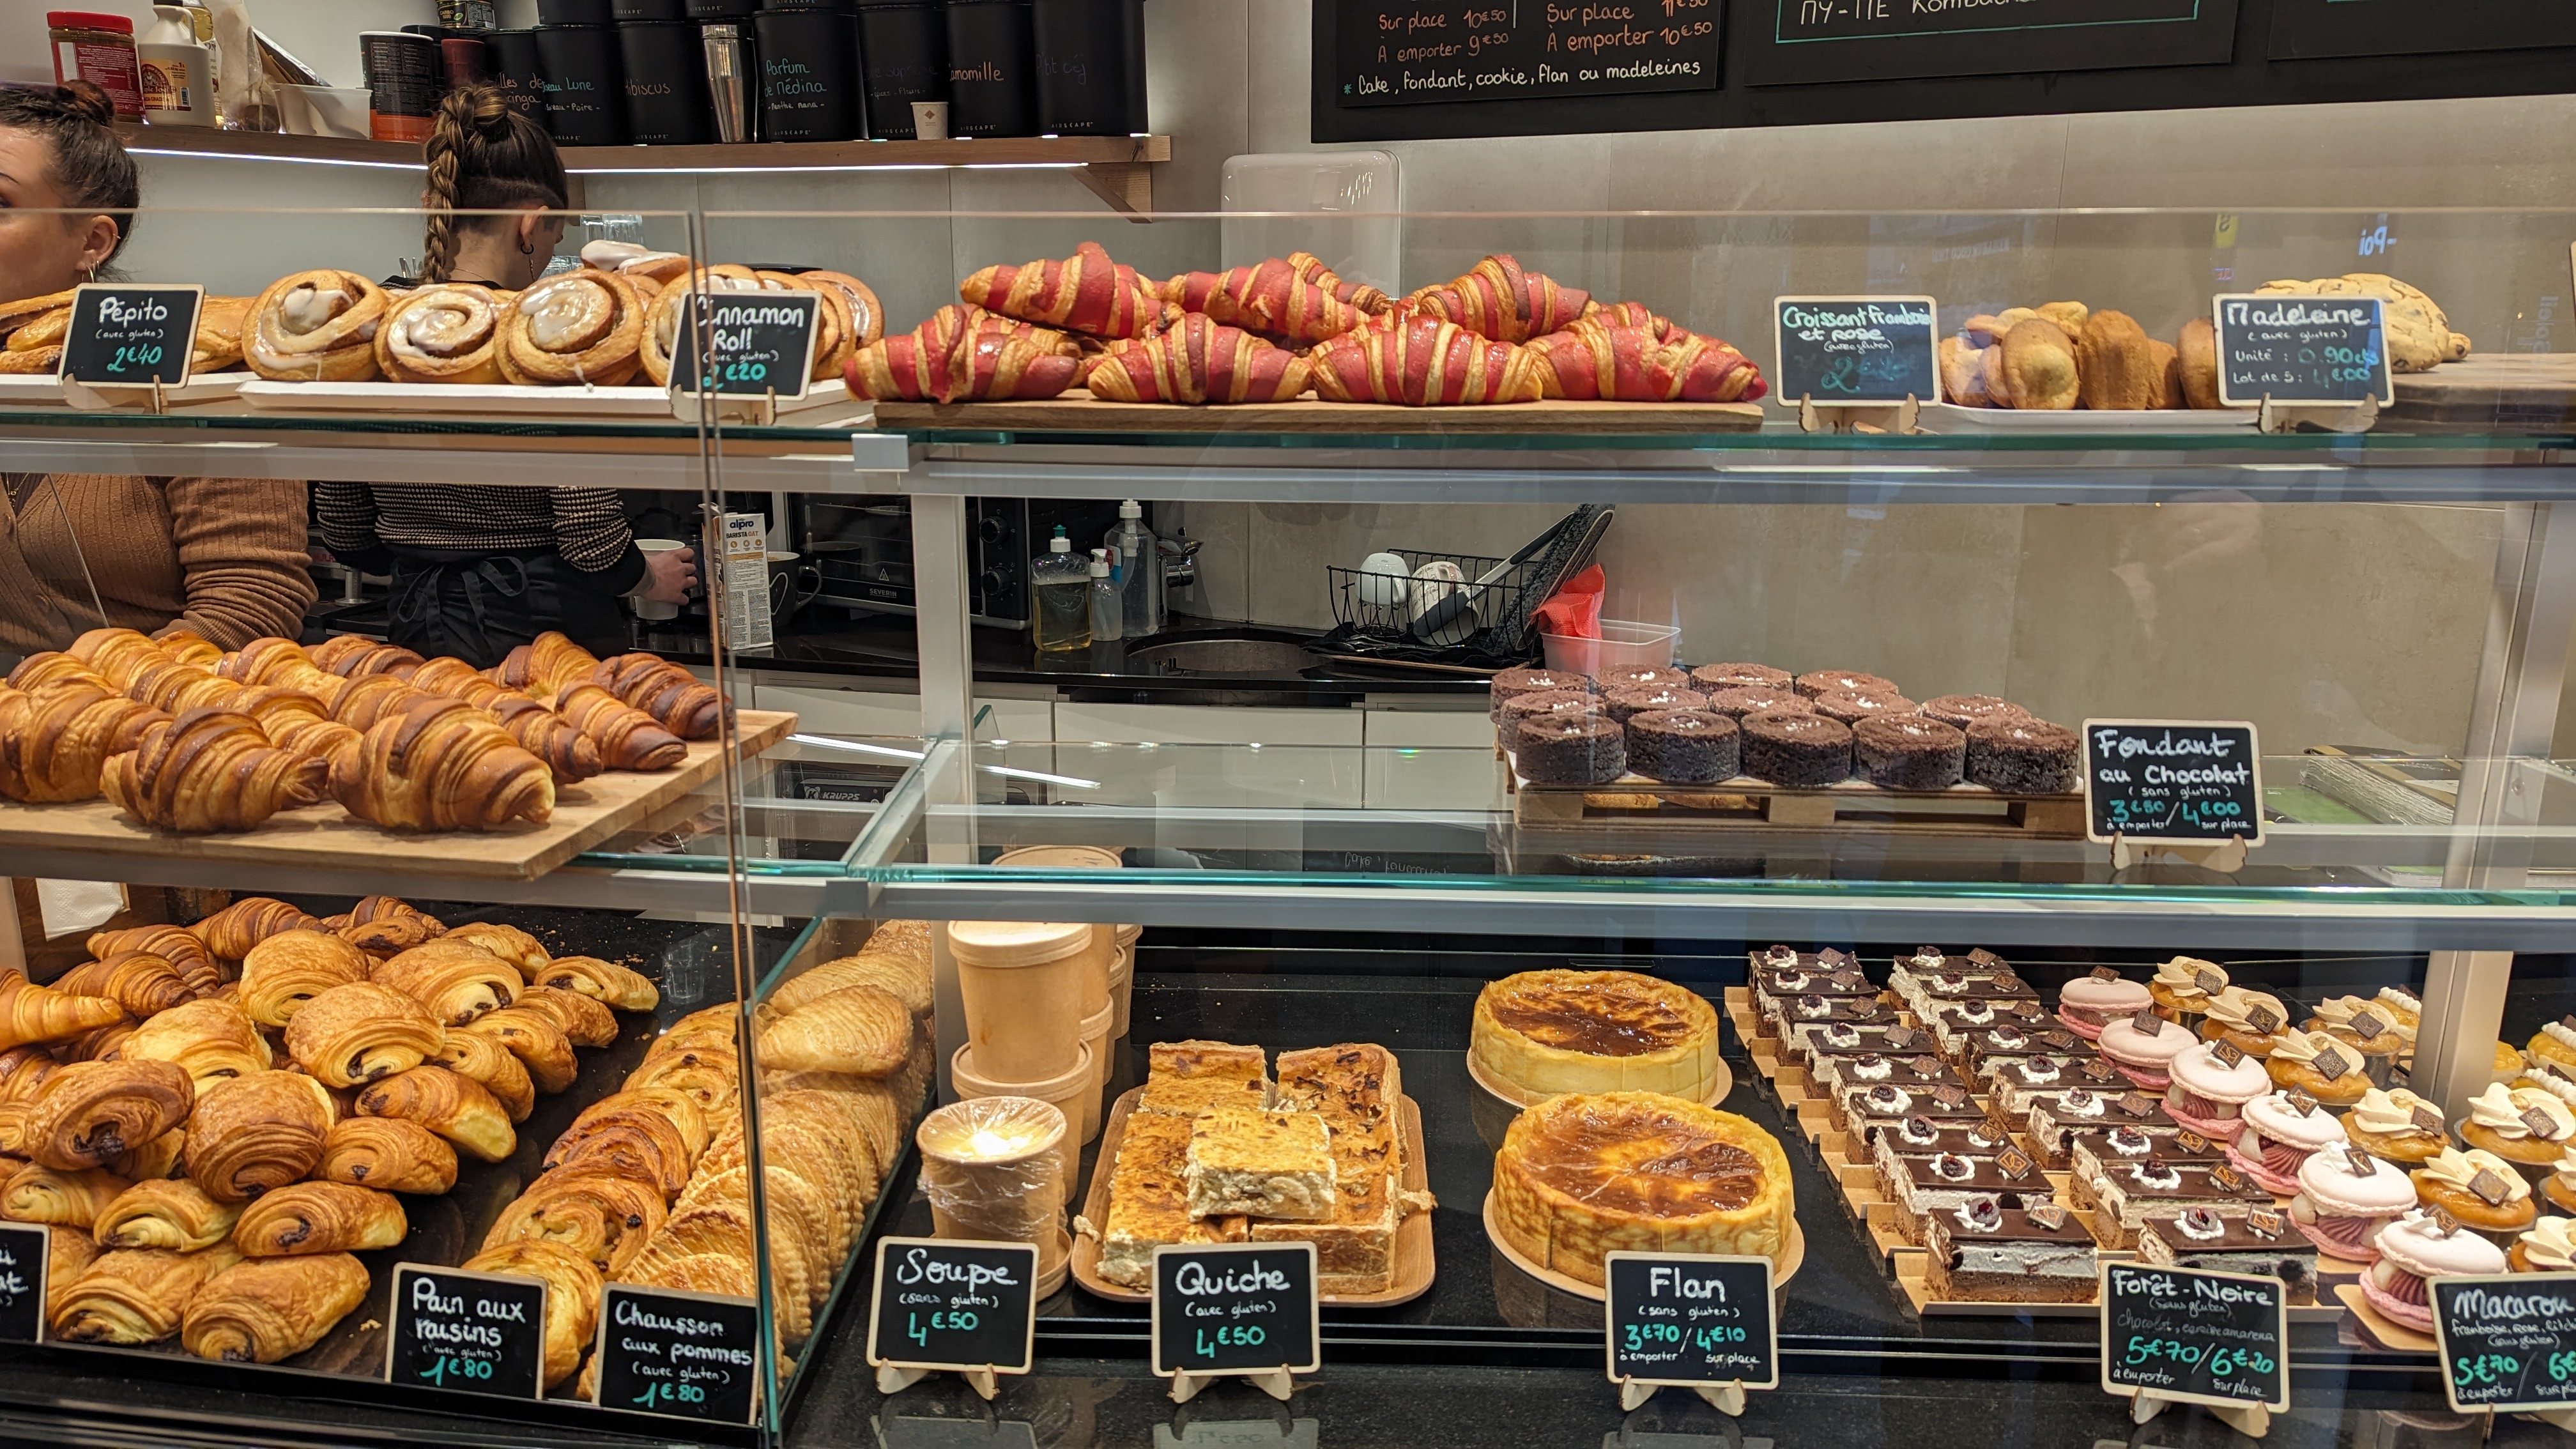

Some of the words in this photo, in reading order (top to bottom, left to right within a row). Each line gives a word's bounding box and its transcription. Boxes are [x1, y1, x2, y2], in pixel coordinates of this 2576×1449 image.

[1379, 13, 1403, 30] Sur
[1409, 11, 1447, 35] place
[1547, 3, 1578, 23] Sur
[1583, 3, 1635, 26] place
[1567, 24, 1654, 56] emporter
[1397, 43, 1462, 63] emporter
[766, 57, 810, 75] Parfum
[949, 61, 1004, 81] amomille
[1539, 64, 1568, 83] flan
[1579, 69, 1599, 80] ou
[1606, 58, 1701, 79] madeleines
[498, 72, 518, 88] lles
[566, 77, 594, 91] Lune
[765, 81, 773, 97] de
[507, 91, 541, 111] ringa
[99, 296, 167, 328] Pépito
[1783, 306, 1868, 328] Croissant
[2227, 302, 2371, 326] Madeleine
[712, 327, 752, 351] Roll
[1798, 328, 1825, 341] et
[1831, 328, 1885, 342] rose
[702, 351, 732, 364] (vec
[2234, 371, 2256, 383] Lot
[2261, 371, 2280, 383] de
[730, 519, 754, 530] alpro
[870, 588, 897, 597] SEVERIN
[2094, 729, 2235, 758] Fondant
[2099, 769, 2131, 783] au
[2144, 762, 2250, 786] Chocolat
[822, 792, 861, 801] KRUPPS
[2106, 818, 2115, 831] à
[2120, 819, 2166, 832] emporter
[2201, 821, 2218, 830] sur
[2221, 818, 2251, 832] place
[896, 1248, 1018, 1293] Soupe
[1176, 1259, 1291, 1296] Quiche
[1650, 1267, 1726, 1303] Flan
[413, 1277, 464, 1315] Pain
[477, 1299, 526, 1323] aux
[2454, 1288, 2575, 1320] Macaron
[615, 1300, 724, 1337] Chausson
[415, 1316, 502, 1347] raisins
[622, 1337, 661, 1355] aux
[670, 1342, 753, 1366] pommes
[1620, 1349, 1628, 1361] à
[1630, 1350, 1678, 1365] emporter
[1705, 1354, 1724, 1363] sur
[1728, 1352, 1761, 1367] place
[2113, 1360, 2122, 1377] à
[2122, 1367, 2175, 1384] emporter
[2212, 1377, 2232, 1392] sur
[2232, 1377, 2267, 1397] place
